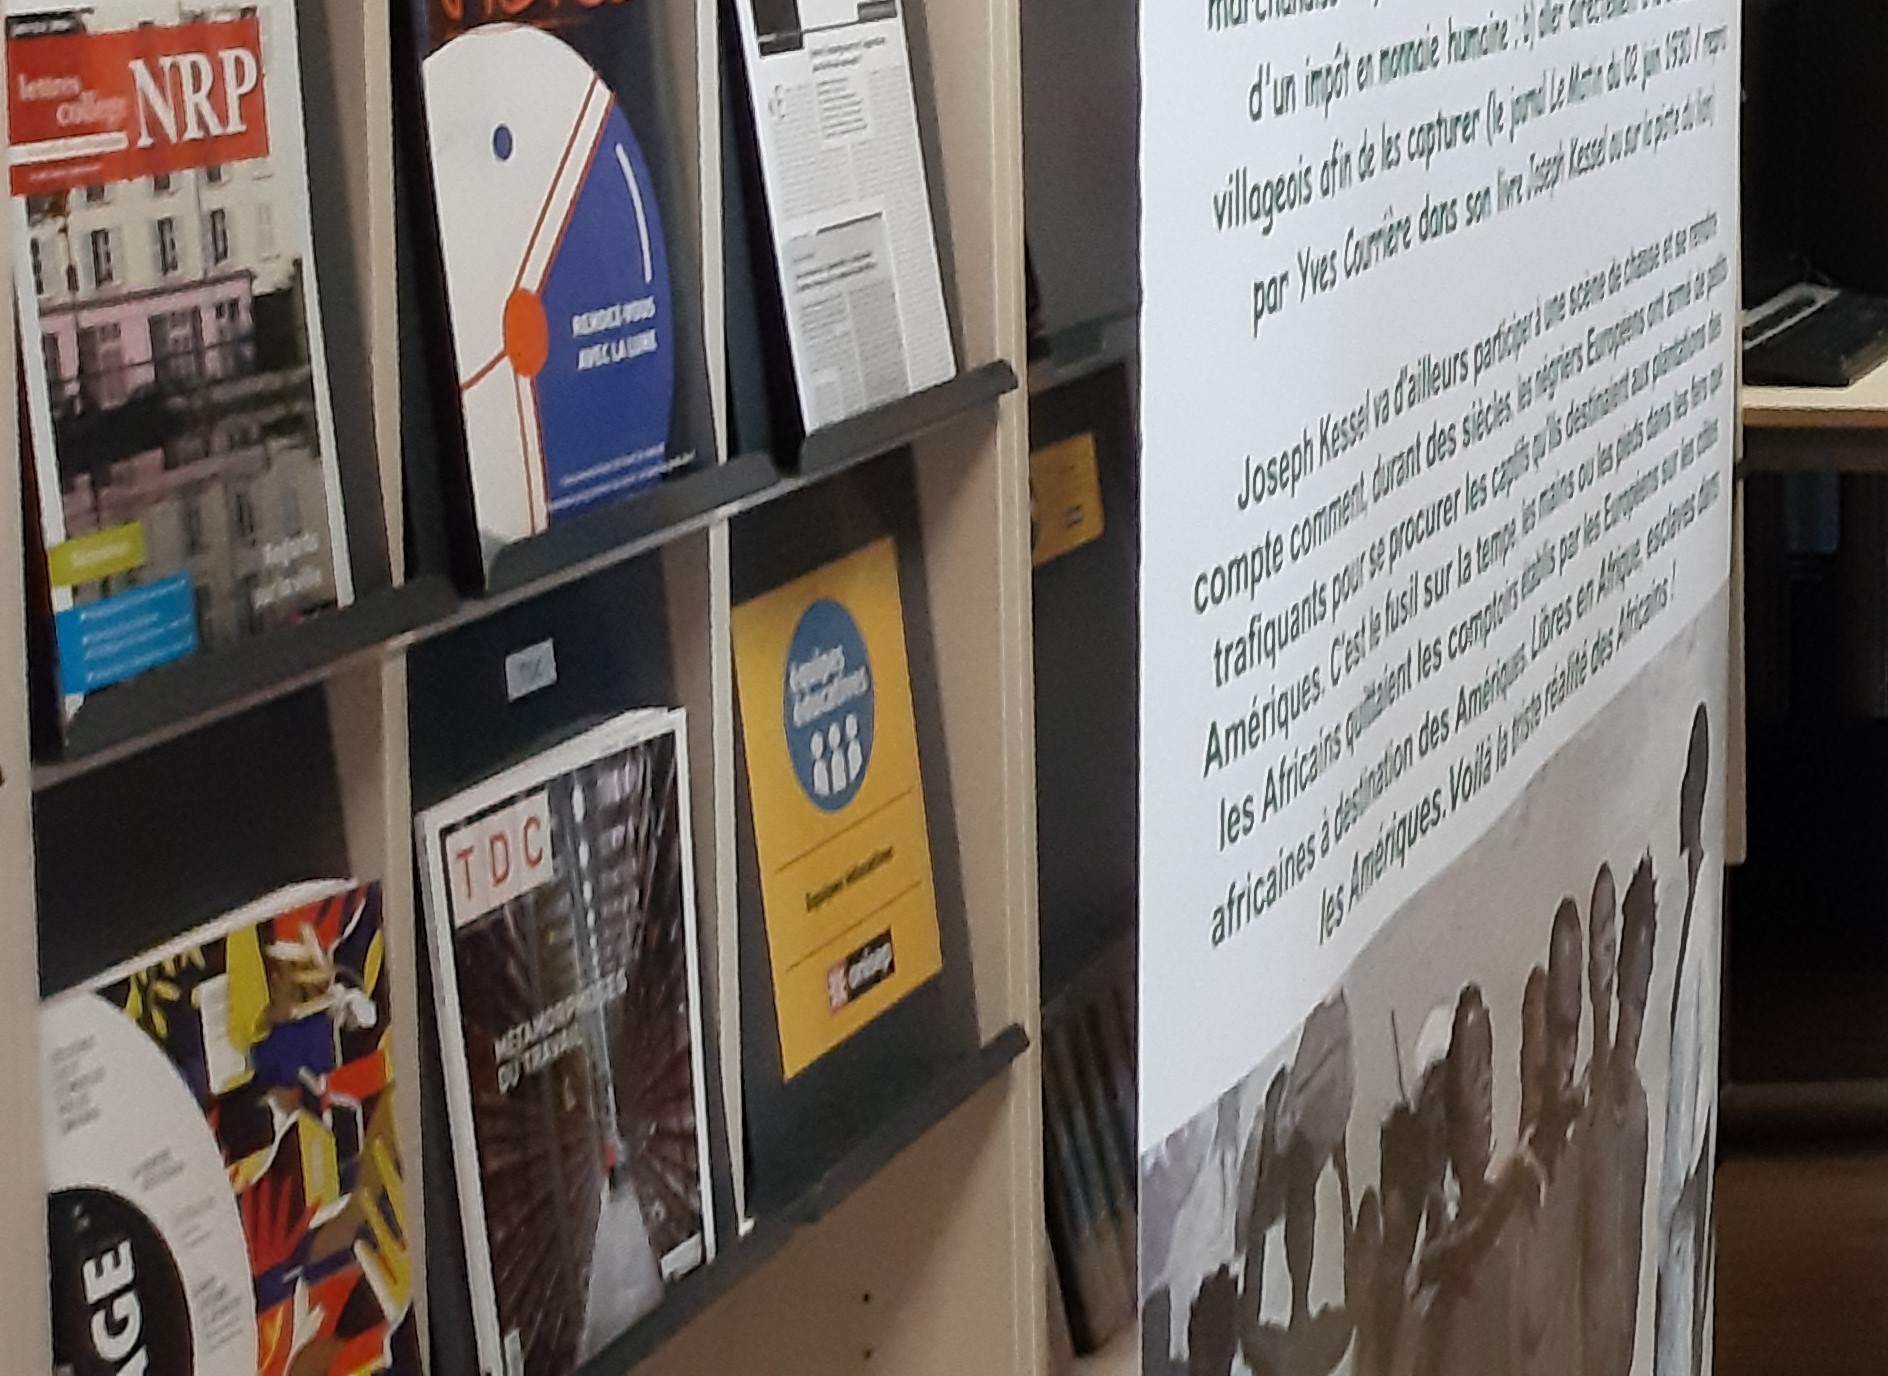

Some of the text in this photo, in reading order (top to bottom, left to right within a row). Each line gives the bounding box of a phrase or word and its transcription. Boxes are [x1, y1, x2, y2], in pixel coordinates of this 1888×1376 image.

[127, 45, 258, 150] NRP
[1248, 62, 1298, 124] d'un
[1304, 42, 1352, 121] impôt
[1212, 109, 1481, 238] villageois afin de les capturer
[1253, 271, 1291, 338] par
[1296, 247, 1339, 304] Yves
[1418, 193, 1459, 245] dans
[1237, 428, 1315, 513] Joseph
[1318, 389, 1371, 469] Kessel
[1373, 389, 1391, 430] va
[1393, 348, 1470, 418] d'ailleurs
[1193, 530, 1285, 617] compte
[1372, 431, 1423, 505] durant
[1425, 420, 1458, 470] des
[1213, 580, 1328, 690] trafiquants
[1368, 537, 1387, 582] se
[1388, 488, 1462, 577] procurer
[1464, 471, 1489, 516] les
[1384, 570, 1420, 639] fusil
[1423, 560, 1455, 611] sur
[1457, 545, 1473, 590] la
[1219, 795, 1256, 854] les
[1260, 723, 1343, 825] Africains
[1416, 637, 1444, 685] les
[456, 814, 545, 901] TDC
[1211, 833, 1317, 949] africaines
[1418, 708, 1451, 760] des
[1319, 884, 1346, 947] les
